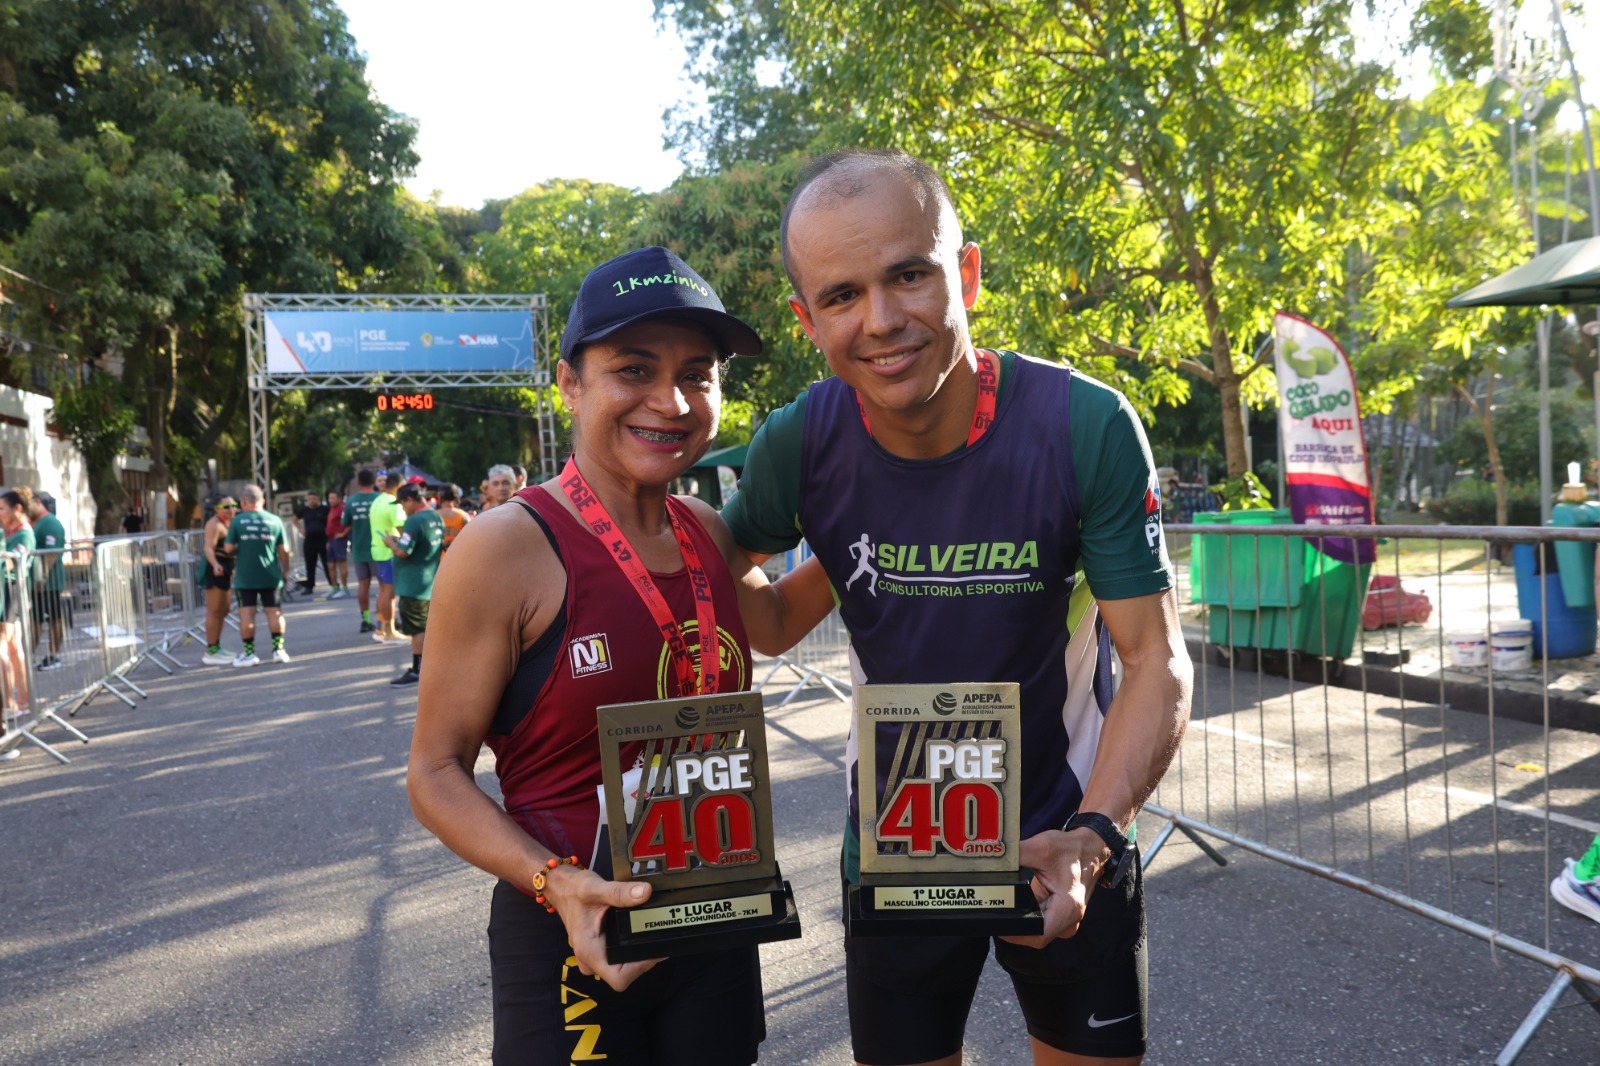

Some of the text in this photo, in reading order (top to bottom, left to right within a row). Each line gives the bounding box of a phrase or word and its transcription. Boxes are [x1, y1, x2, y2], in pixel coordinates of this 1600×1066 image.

[359, 329, 387, 341] PGE
[976, 357, 997, 398] PGE
[1285, 381, 1320, 402] COCO
[1288, 389, 1352, 420] GELADO
[1311, 417, 1355, 436] AQUI
[562, 474, 598, 513] PGE
[877, 540, 1039, 573] SILVEIRA
[640, 575, 655, 592] PGE
[688, 564, 712, 603] PGE
[878, 579, 1045, 597] CONSULTORIA ESPORTIVA
[570, 632, 602, 645] ACADEMIA
[661, 621, 689, 665] PGE
[702, 634, 710, 654] PGE
[576, 661, 608, 675] FITNESS
[962, 693, 1003, 704] APEPA
[706, 702, 745, 716] APEPA
[866, 707, 921, 716] CORRIDA
[607, 723, 663, 737] CORRIDA
[929, 743, 1003, 780] PGE
[675, 752, 753, 796] PGE
[879, 783, 999, 853] 40
[631, 793, 753, 870] 40
[965, 842, 1003, 854] anos
[720, 852, 757, 865] anos
[928, 888, 976, 900] LUGAR
[931, 899, 983, 907] COMUNIDADE
[685, 901, 733, 917] LUGAR
[644, 918, 683, 929] FEMININO
[684, 911, 737, 924] COMUNIDADE
[742, 908, 758, 916] 7KM
